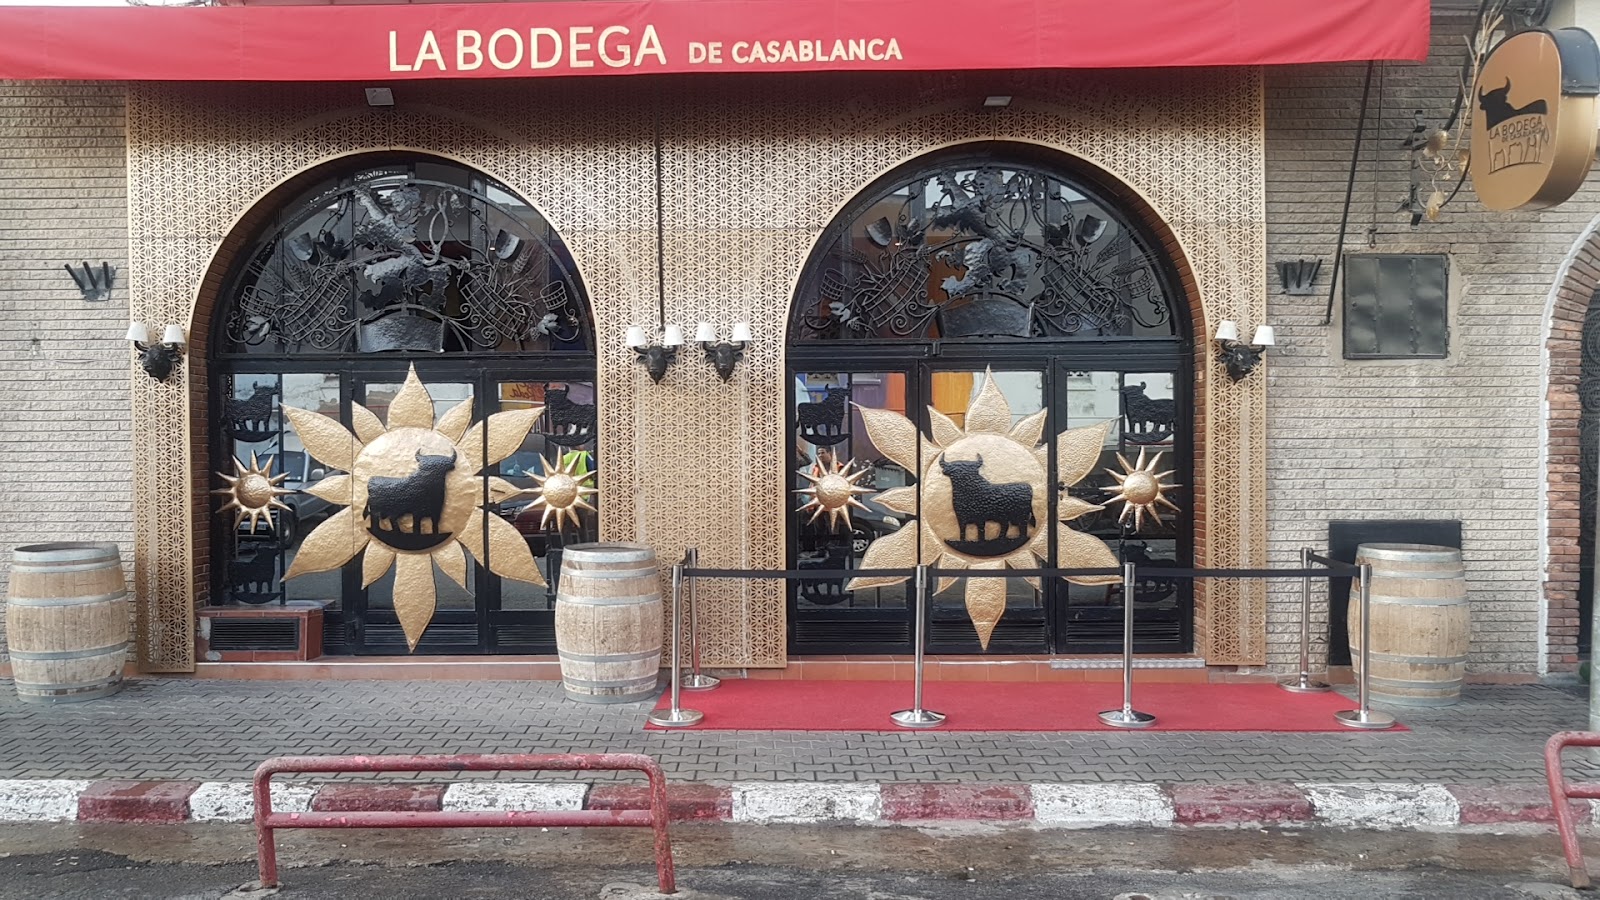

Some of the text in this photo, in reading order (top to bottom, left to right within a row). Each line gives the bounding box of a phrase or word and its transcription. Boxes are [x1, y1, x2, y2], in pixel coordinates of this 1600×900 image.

[389, 24, 903, 72] LA BODEGA DE CASABLANCA
[1489, 116, 1543, 139] LA BODEGA
